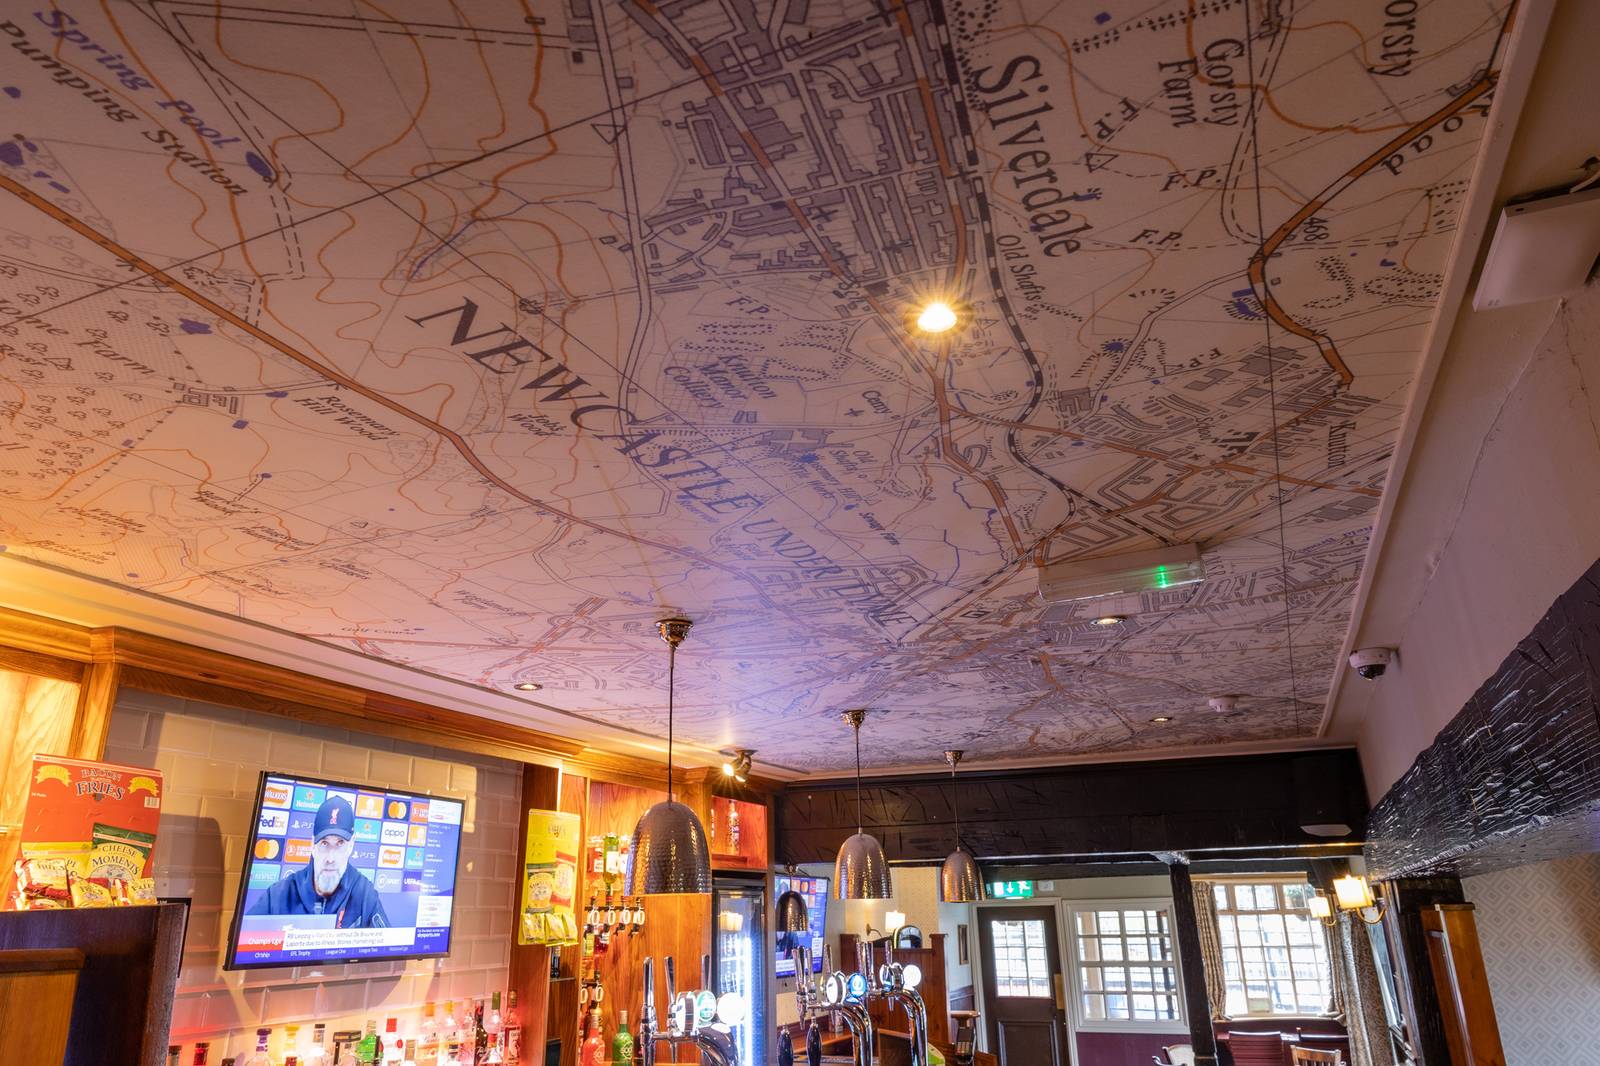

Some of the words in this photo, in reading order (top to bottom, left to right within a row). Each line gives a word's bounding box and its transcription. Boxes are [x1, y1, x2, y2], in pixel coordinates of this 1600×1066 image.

[34, 9, 155, 91] Spring
[156, 99, 242, 150] Pool
[1158, 56, 1200, 128] Farm
[1203, 38, 1245, 127] Gorsty
[141, 127, 249, 197] Station
[974, 55, 1094, 258] Silverdale
[1159, 169, 1222, 192] F.P.
[1129, 228, 1183, 247] F.P.
[1303, 216, 1329, 242] 468
[996, 234, 1020, 262] Old
[1009, 263, 1046, 303] Shafts
[0, 299, 69, 335] ome
[726, 296, 771, 320] F.P.
[76, 339, 156, 377] Farm
[717, 353, 779, 400] Knutton
[664, 366, 725, 410] Colliery
[694, 362, 749, 400] Manor
[292, 398, 337, 415] Hill
[333, 416, 390, 441] Wood
[317, 396, 401, 437] Rosemary
[507, 413, 561, 438] Wood
[405, 296, 763, 515] NEWCASTLE
[742, 518, 845, 580] UNDER
[1327, 420, 1356, 469] Knutton
[829, 450, 858, 471] Shafts
[853, 450, 877, 465] Old
[75, 780, 125, 800] FRIES
[102, 845, 137, 858] CHEESE
[385, 829, 405, 838] oppo
[92, 855, 139, 876] MOMENTS
